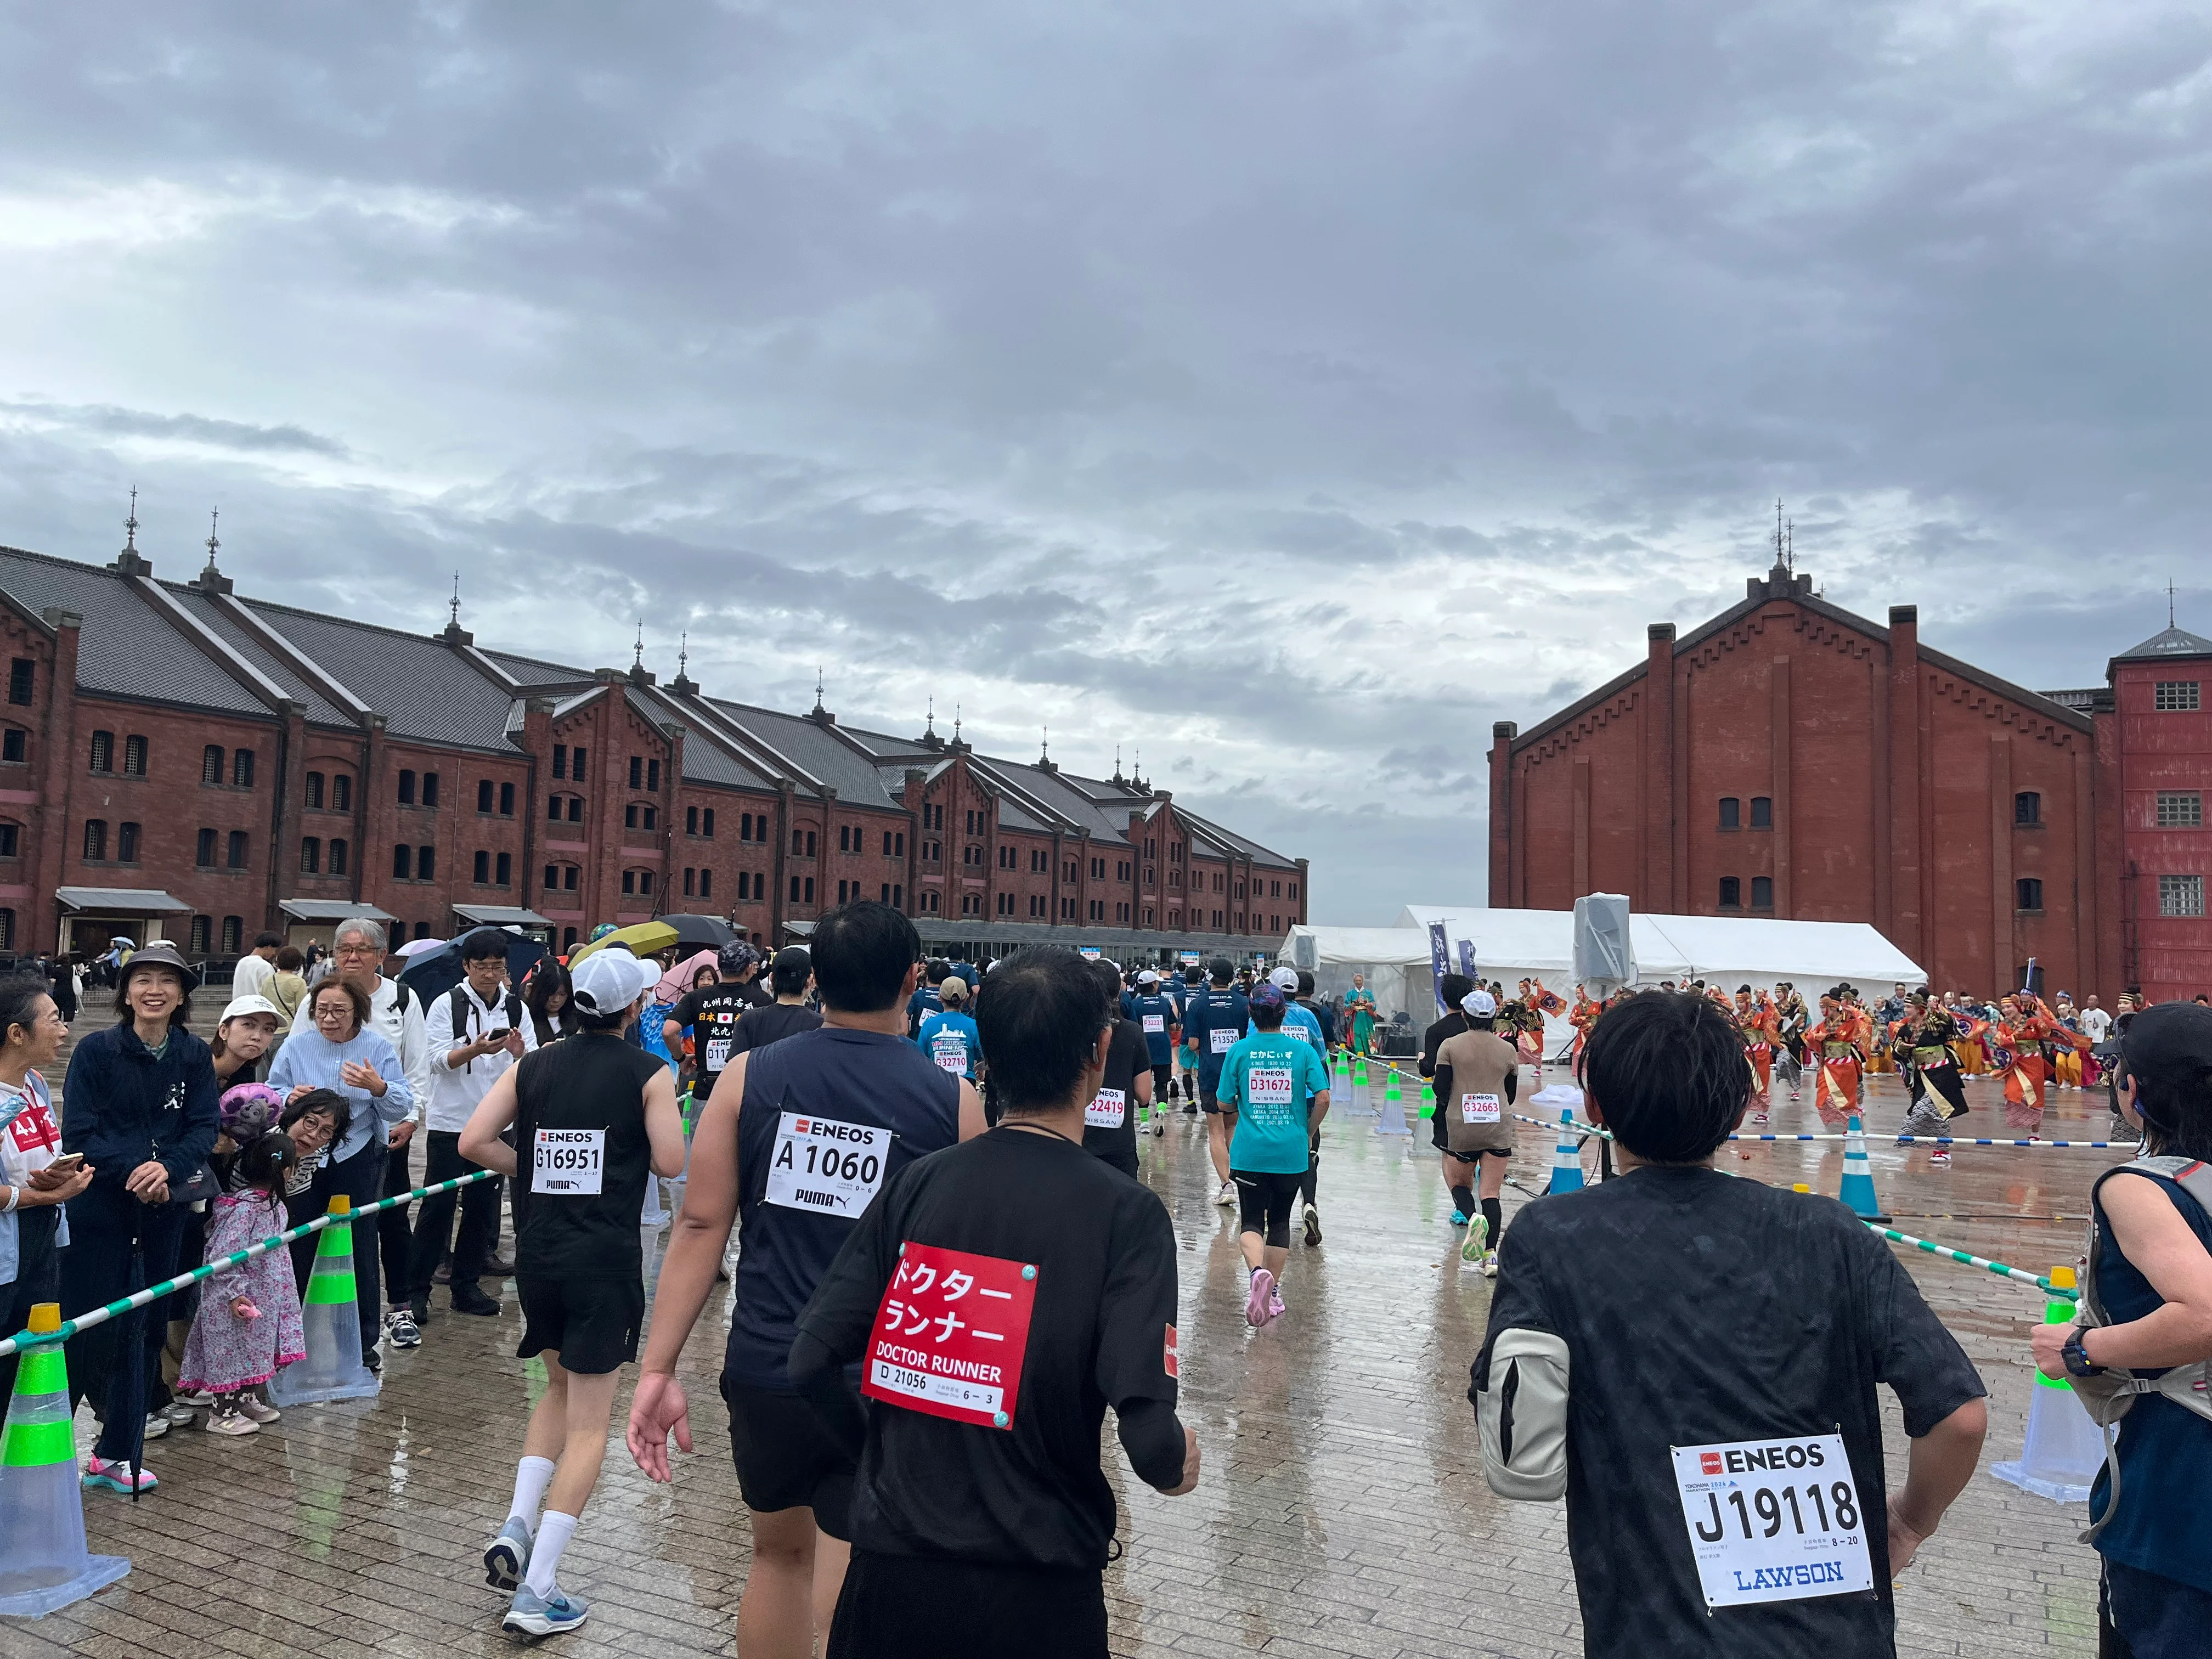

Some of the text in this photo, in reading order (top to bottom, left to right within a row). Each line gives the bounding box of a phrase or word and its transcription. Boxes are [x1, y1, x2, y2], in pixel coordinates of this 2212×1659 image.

[699, 1012, 716, 1022] 日本
[711, 1026, 733, 1036] 北九
[1283, 1034, 1308, 1042] 5571
[1212, 1035, 1238, 1044] F13520
[936, 1057, 966, 1066] G32710
[1251, 1079, 1290, 1091] D31672
[1090, 1099, 1123, 1114] 32419
[1464, 1102, 1498, 1111] G32663
[549, 1133, 592, 1142] ENEOS
[810, 1121, 874, 1145] ENEOS
[537, 1148, 599, 1169] G16951
[546, 1180, 570, 1189] PUMA
[795, 1189, 834, 1207] PUMA
[893, 1258, 1012, 1301] ドクター
[885, 1299, 1005, 1343] ランナー
[876, 1340, 1001, 1384] DOCTOR RUNNER
[1725, 1443, 1824, 1473] ENEOS
[1695, 1481, 1858, 1542] J19118
[1734, 1561, 1844, 1591] LAWSON
